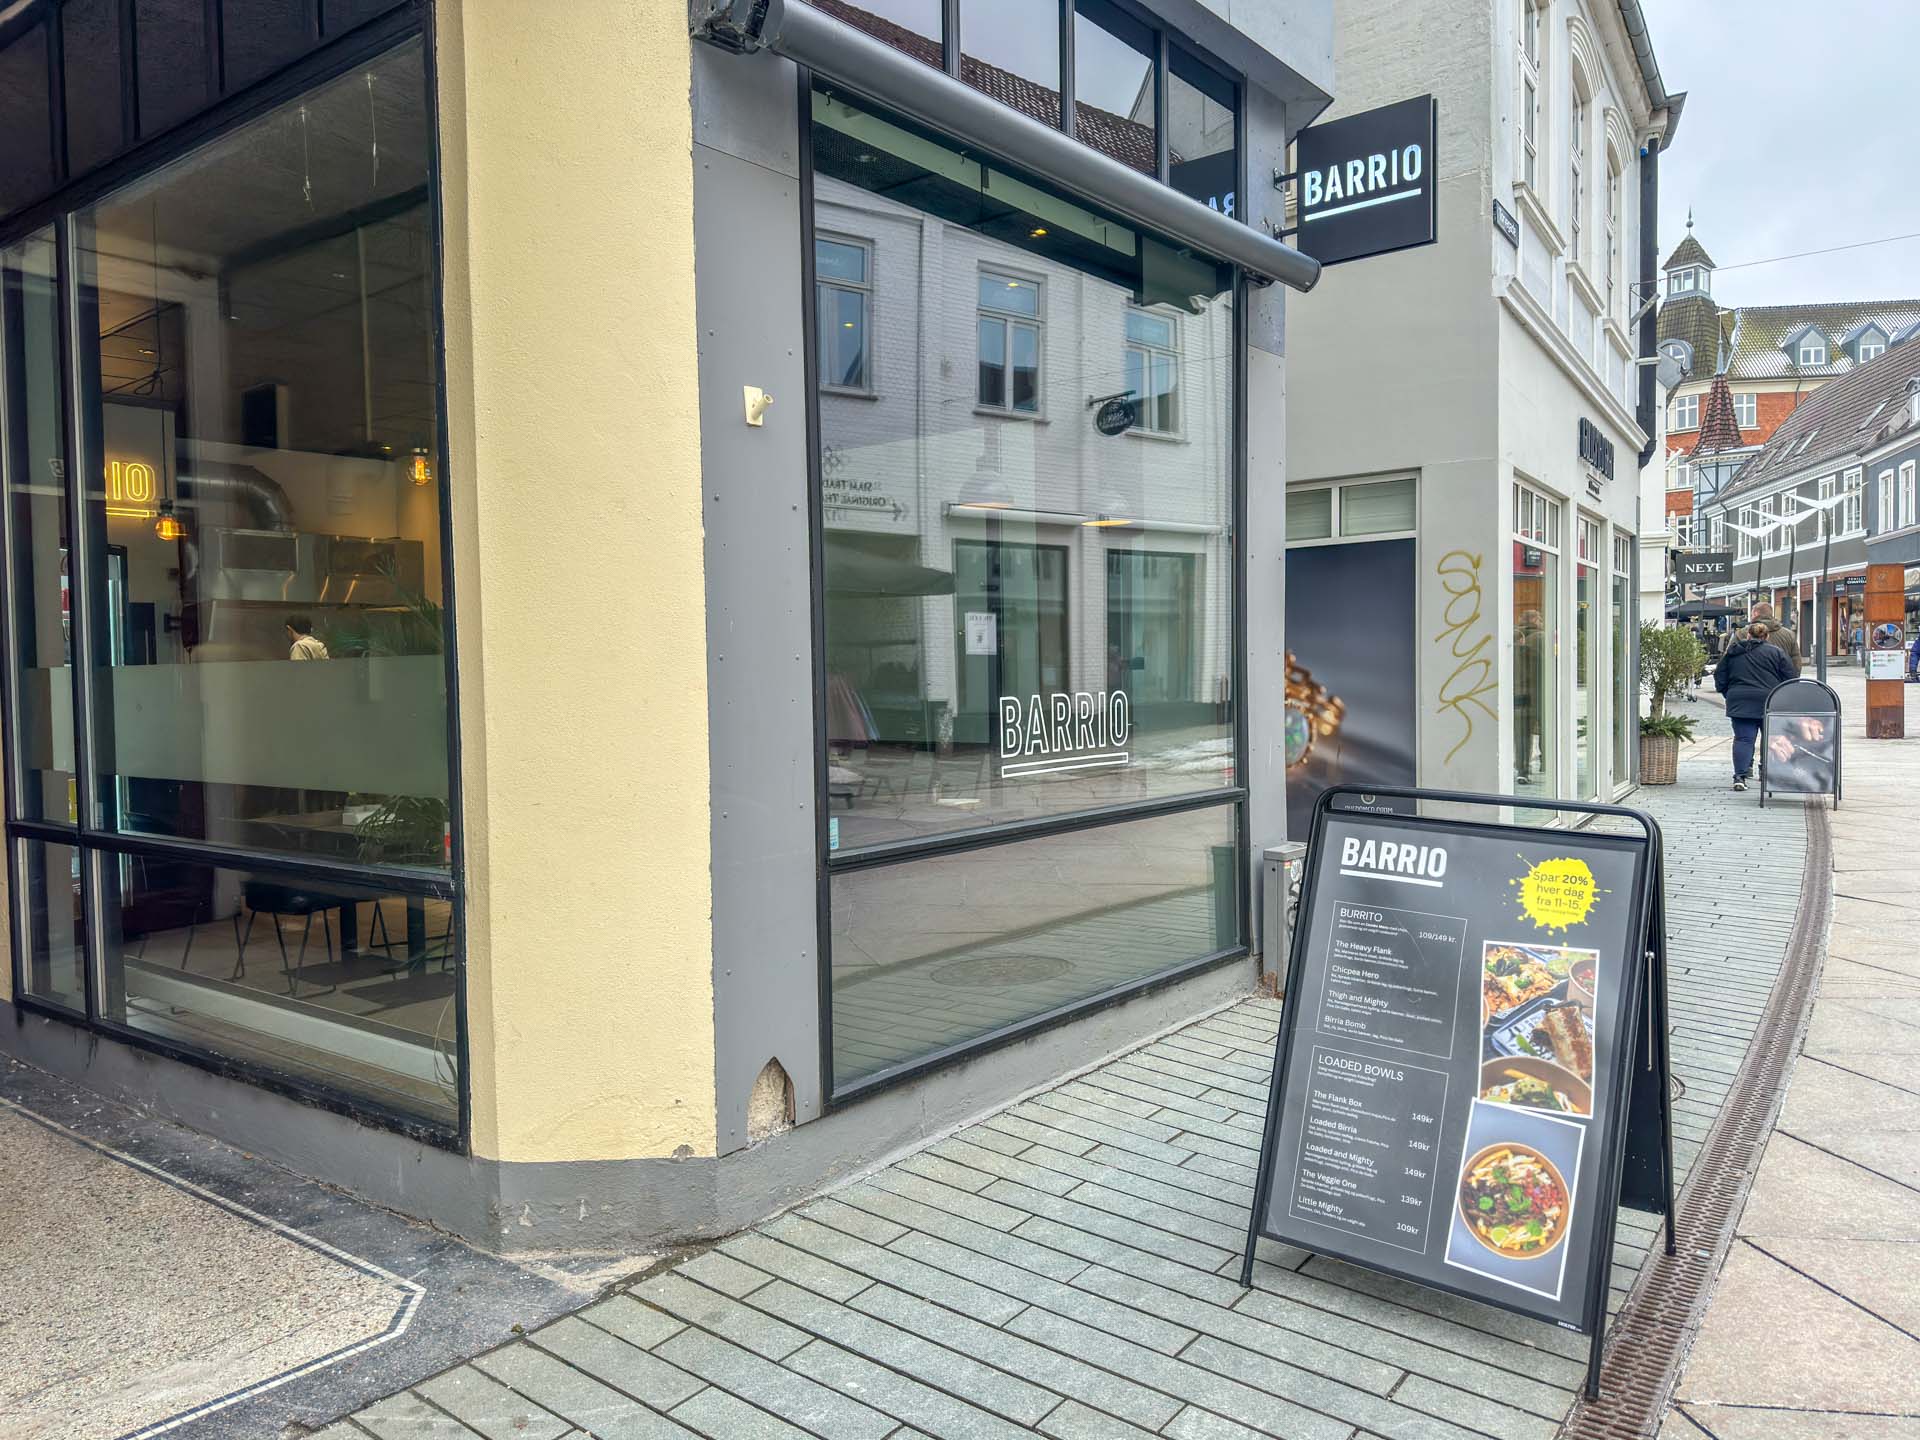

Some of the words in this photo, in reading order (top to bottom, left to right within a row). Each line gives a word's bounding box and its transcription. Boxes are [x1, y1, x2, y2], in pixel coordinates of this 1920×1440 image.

[1304, 143, 1422, 208] BARRIO
[1684, 562, 1725, 573] NEYE
[1000, 690, 1129, 759] BARRIO
[1341, 837, 1448, 878] BARRIO
[1533, 871, 1560, 882] Spar
[1562, 874, 1588, 886] 20%
[1536, 884, 1560, 895] hver
[1563, 887, 1584, 900] dag
[1536, 896, 1551, 906] fra
[1340, 907, 1383, 922] BURRITO
[1419, 931, 1447, 943] 109/149
[1335, 939, 1349, 948] The
[1350, 942, 1372, 953] Heavy
[1373, 946, 1392, 956] Flank
[1361, 970, 1379, 980] Hero
[1328, 989, 1348, 1001] Thigh
[1349, 993, 1363, 1002] and
[1363, 996, 1389, 1009] Mighty
[1324, 1015, 1344, 1026] Birria
[1344, 1019, 1367, 1030] Bomb
[1318, 1054, 1363, 1072] LOADED
[1364, 1064, 1404, 1081] BOWLS
[1314, 1090, 1327, 1100] The
[1328, 1093, 1347, 1104] Flank
[1348, 1098, 1363, 1108] Box
[1309, 1116, 1337, 1129] Loaded
[1337, 1122, 1358, 1134] Birria
[1411, 1112, 1434, 1124] 149kr
[1408, 1140, 1430, 1152] 149kr
[1306, 1142, 1333, 1156] Loaded
[1333, 1149, 1348, 1160] and
[1348, 1153, 1375, 1167] Mighty
[1302, 1168, 1316, 1179] The
[1317, 1171, 1341, 1185] Veggie
[1341, 1179, 1357, 1190] One
[1404, 1167, 1427, 1179] 149kr
[1298, 1195, 1318, 1207] Little
[1318, 1200, 1344, 1215] Mighty
[1400, 1194, 1423, 1207] 139kr
[1396, 1222, 1420, 1235] 109kr
